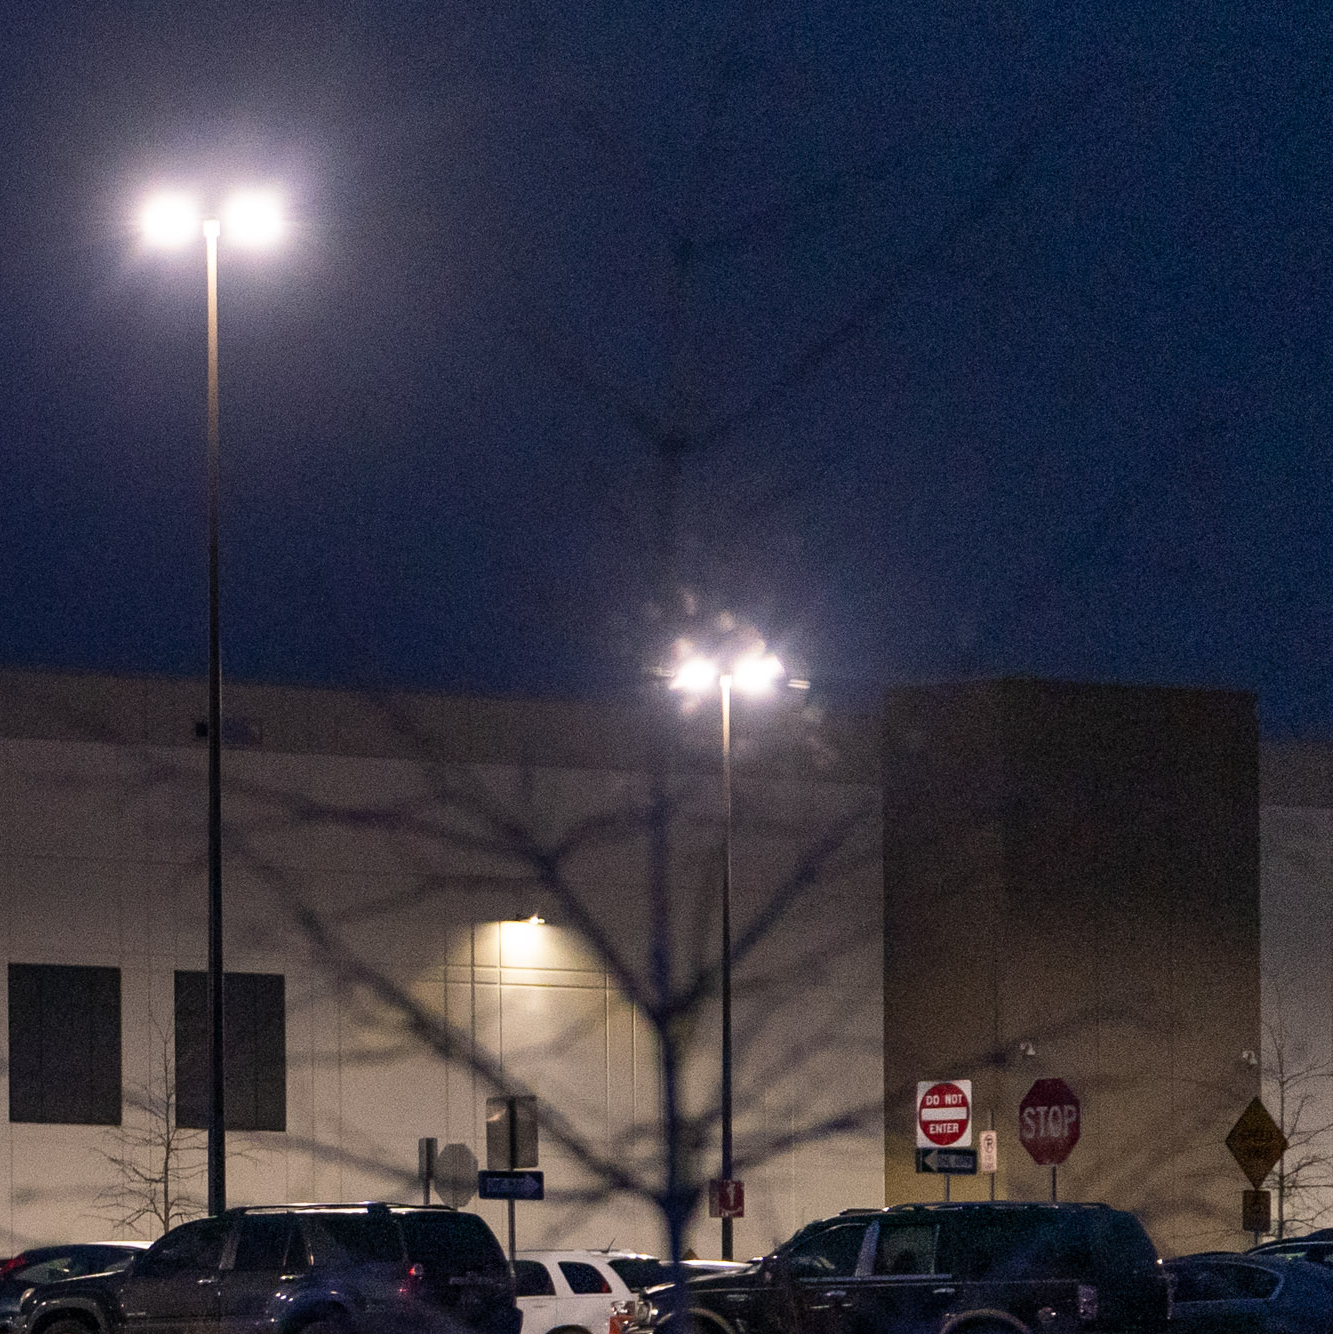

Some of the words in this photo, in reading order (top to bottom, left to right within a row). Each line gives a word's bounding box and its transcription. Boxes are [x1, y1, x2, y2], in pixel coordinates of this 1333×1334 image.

[926, 1094, 940, 1106] DO
[944, 1093, 963, 1105] NOT
[1024, 1105, 1077, 1138] STOP
[929, 1123, 959, 1135] ENTER
